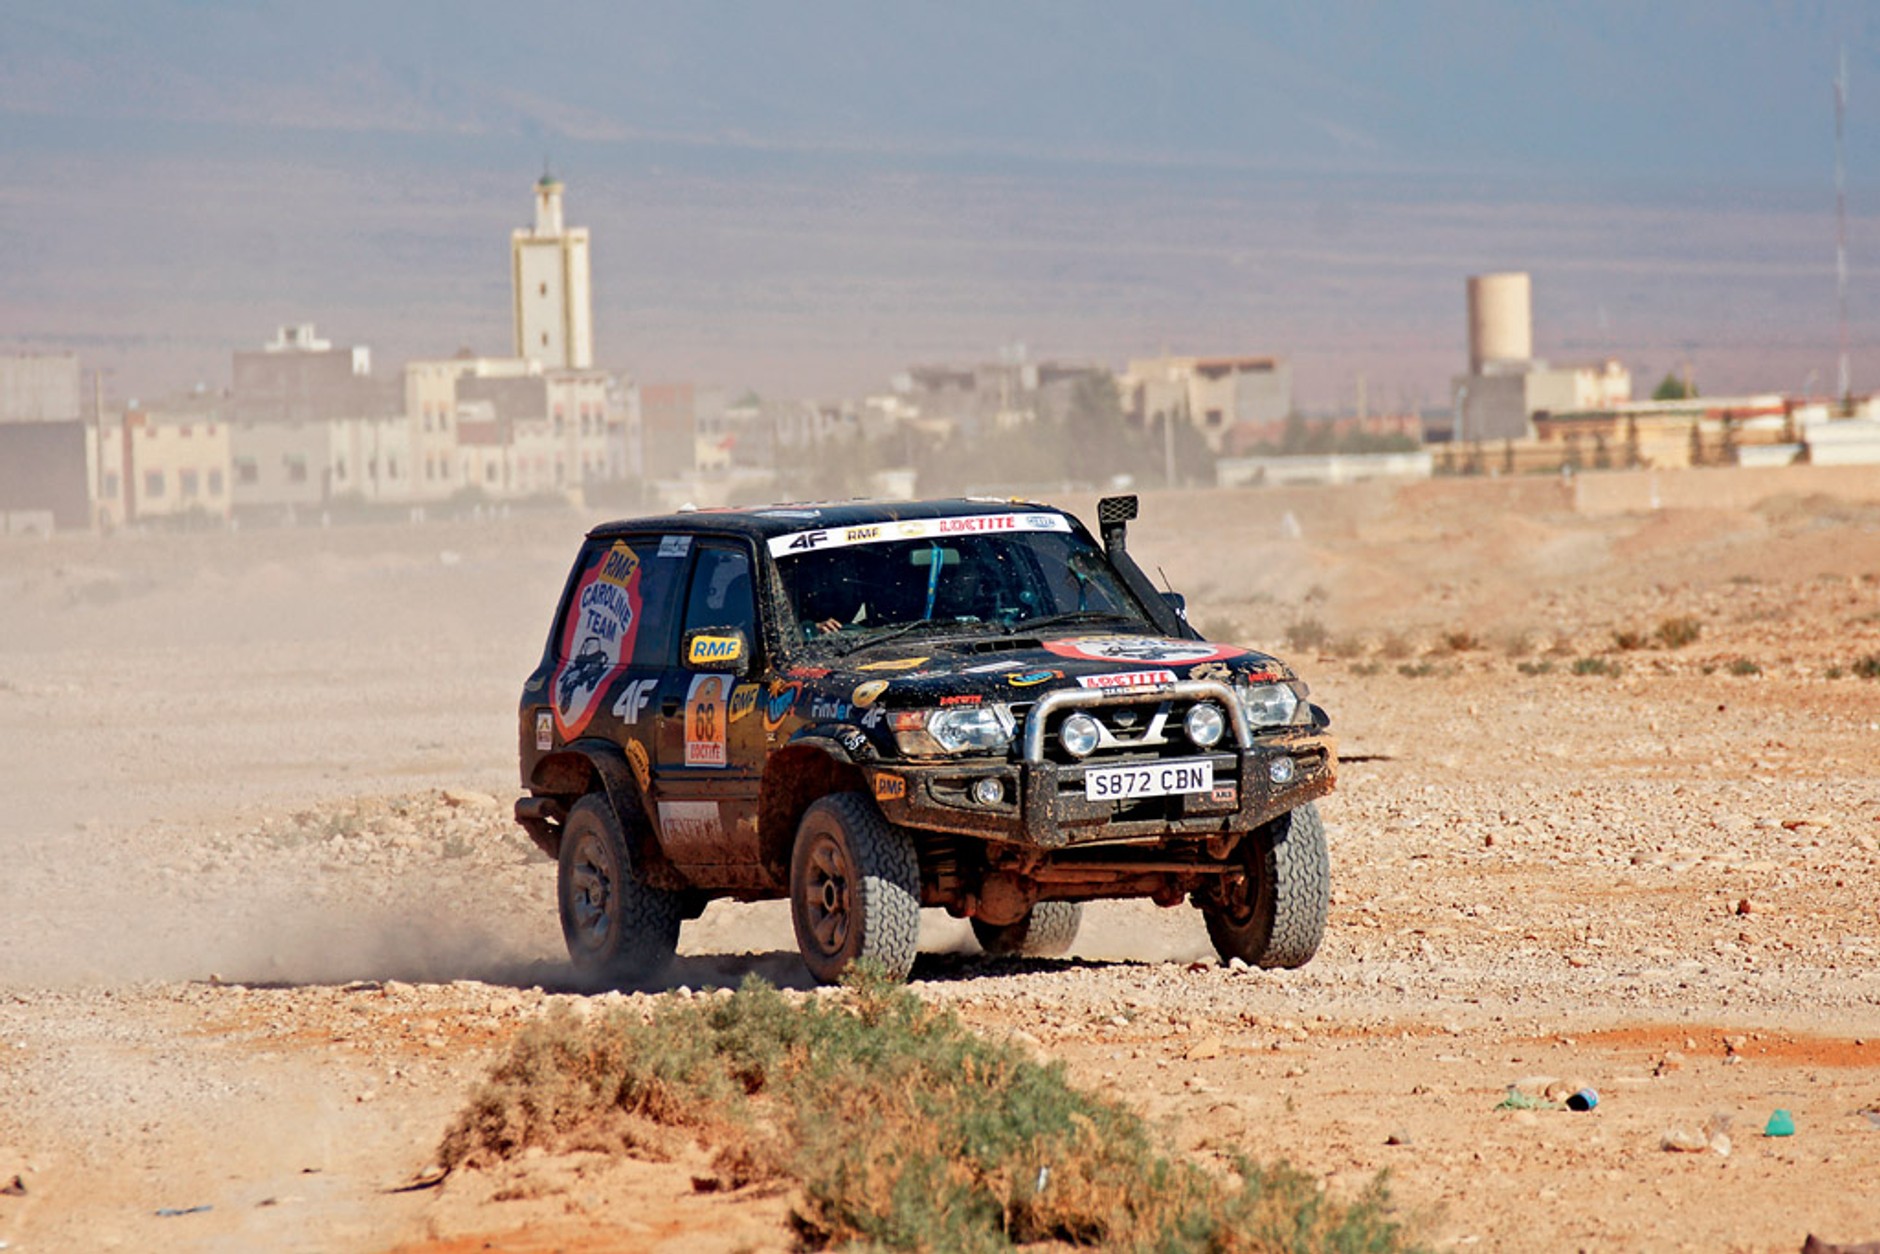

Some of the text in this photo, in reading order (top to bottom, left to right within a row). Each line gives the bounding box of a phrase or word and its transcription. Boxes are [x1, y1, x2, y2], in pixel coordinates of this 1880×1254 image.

[789, 531, 827, 548] 4F
[847, 528, 878, 541] RMF
[940, 517, 1014, 532] LOCTITE
[603, 550, 636, 581] RMF
[582, 583, 631, 632] CAROLINE
[587, 609, 617, 642] TEAM
[694, 641, 737, 656] RMF
[1087, 672, 1169, 688] LOCTITE
[612, 679, 658, 724] 4F
[731, 689, 757, 714] RMF
[880, 779, 903, 794] RMF
[1096, 768, 1203, 795] S872 CBN
